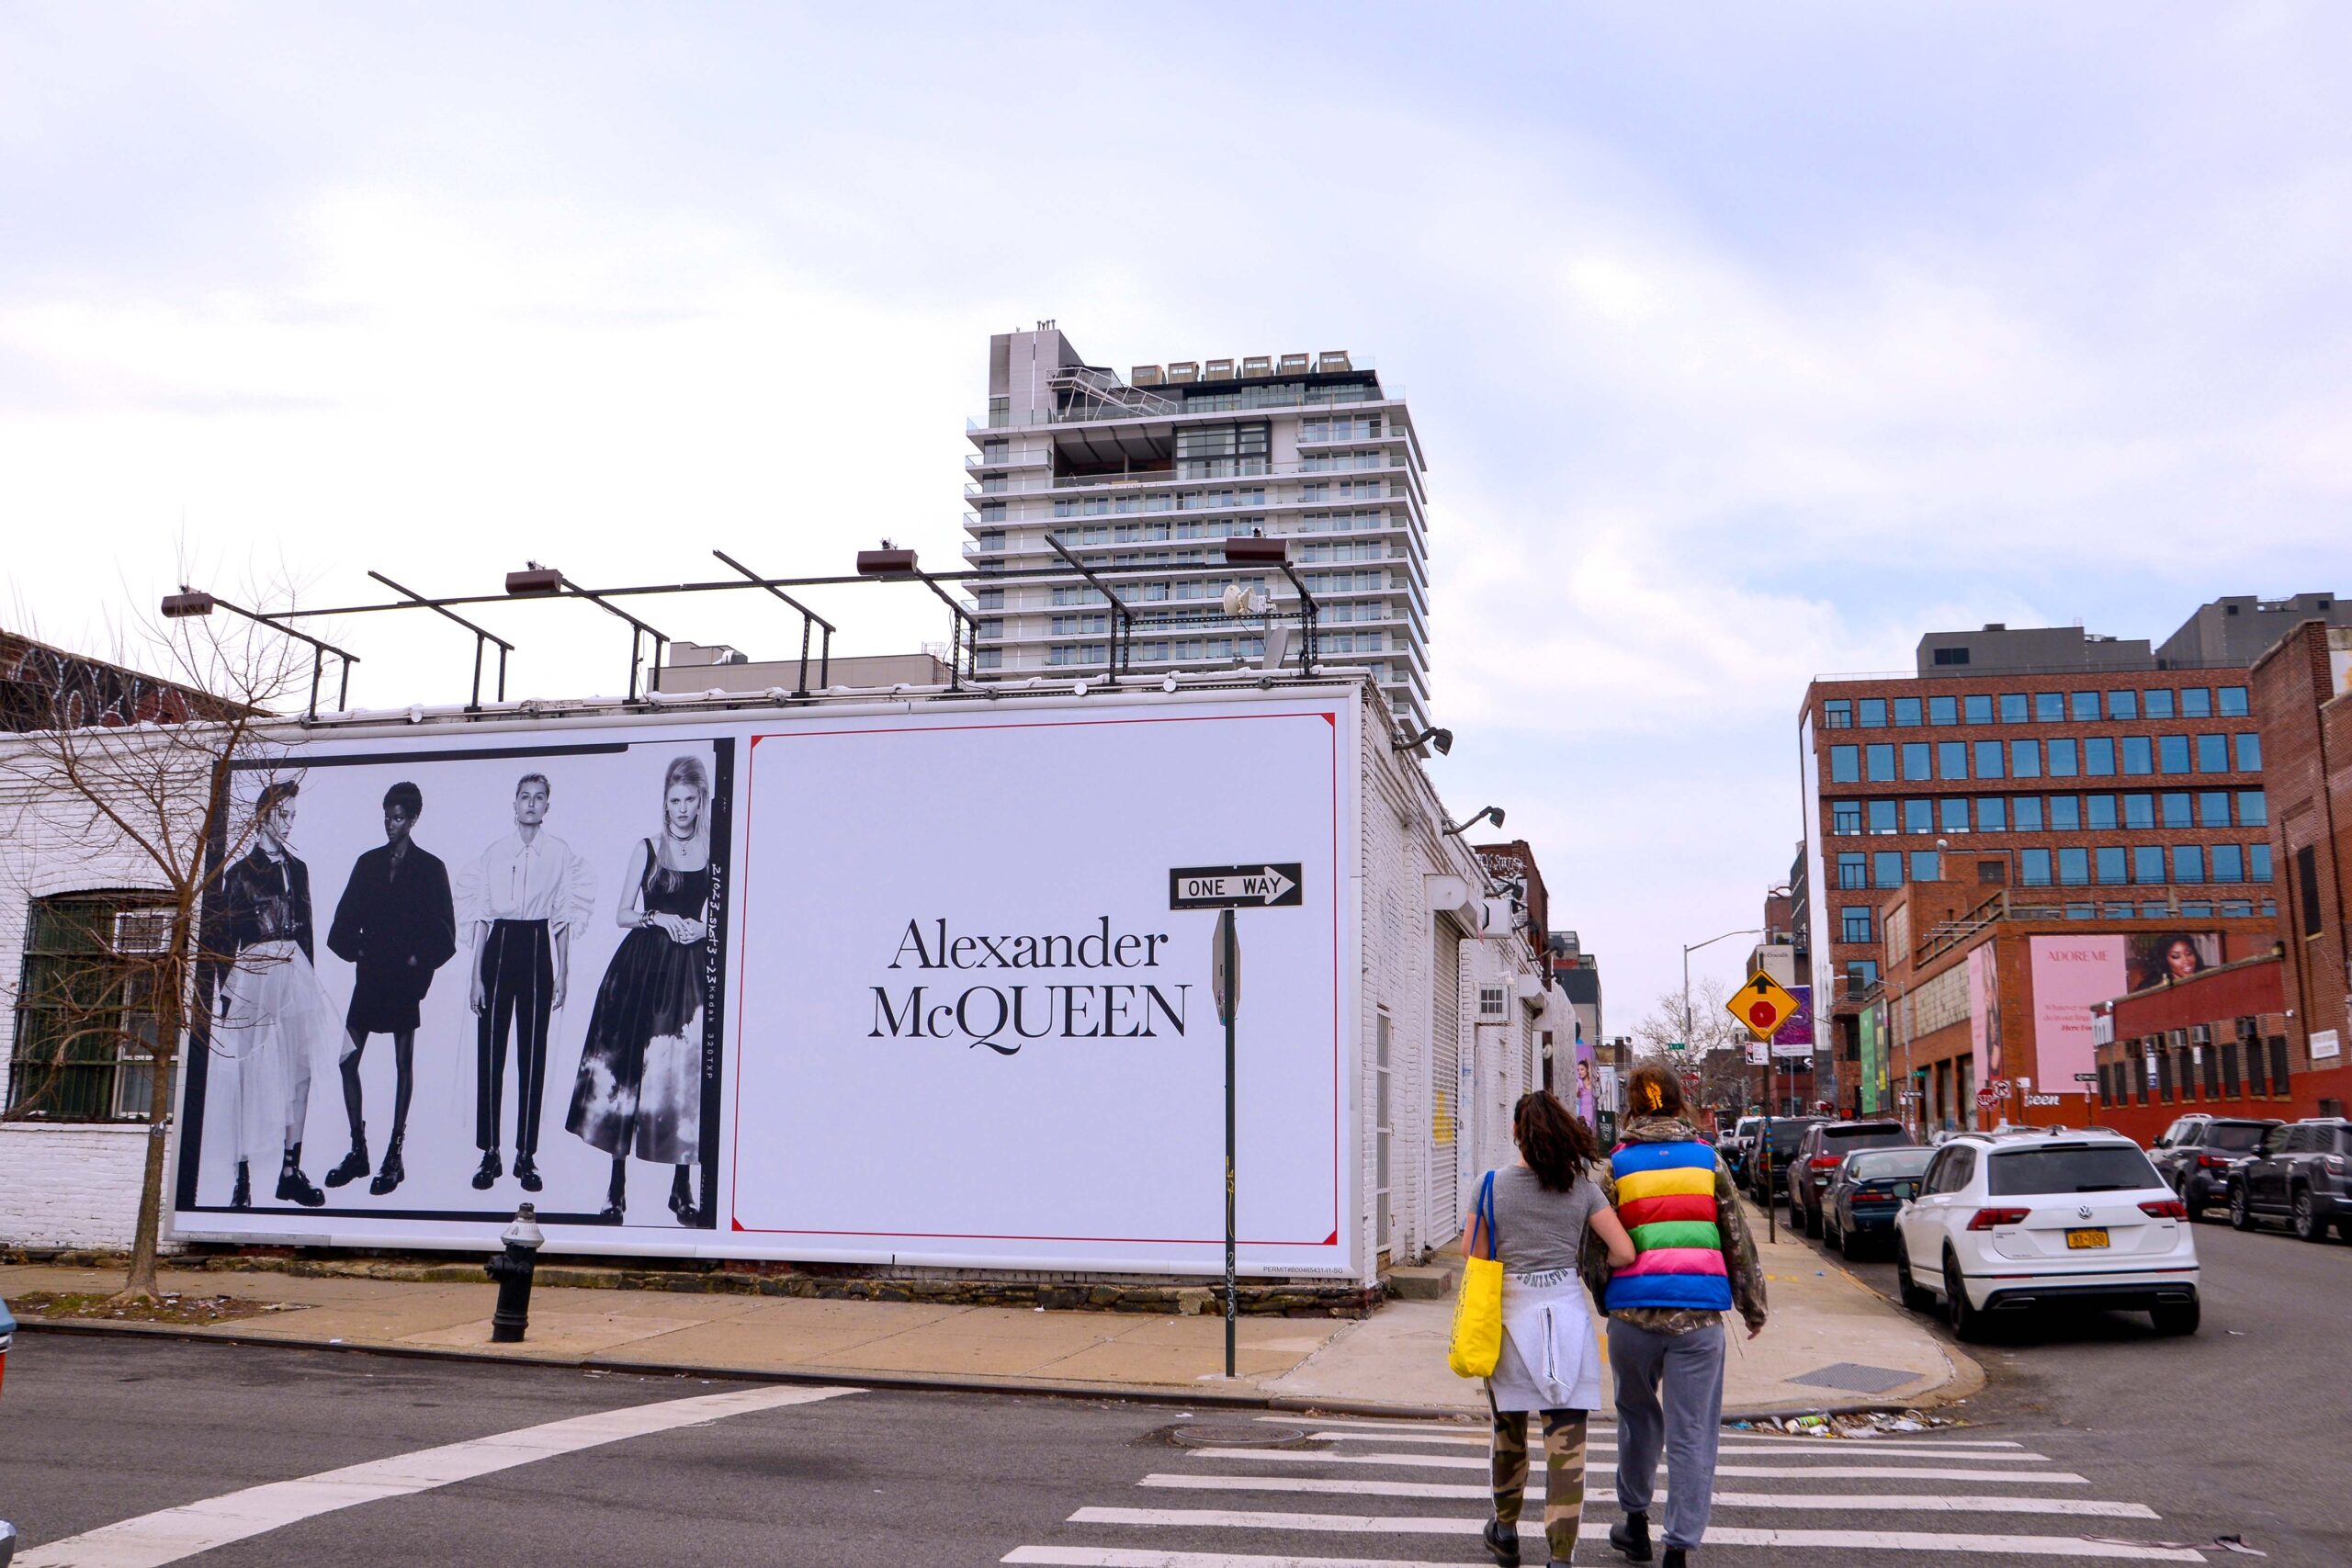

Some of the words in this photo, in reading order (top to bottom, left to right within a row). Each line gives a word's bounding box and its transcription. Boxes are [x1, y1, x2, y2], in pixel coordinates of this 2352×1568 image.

[1189, 879, 1225, 897] ONE
[1243, 877, 1282, 895] WAY
[888, 915, 1169, 970] Alexander
[707, 986, 716, 1022] Kodak
[867, 983, 1193, 1055] McQUEEN
[706, 1032, 715, 1079] 320TXP
